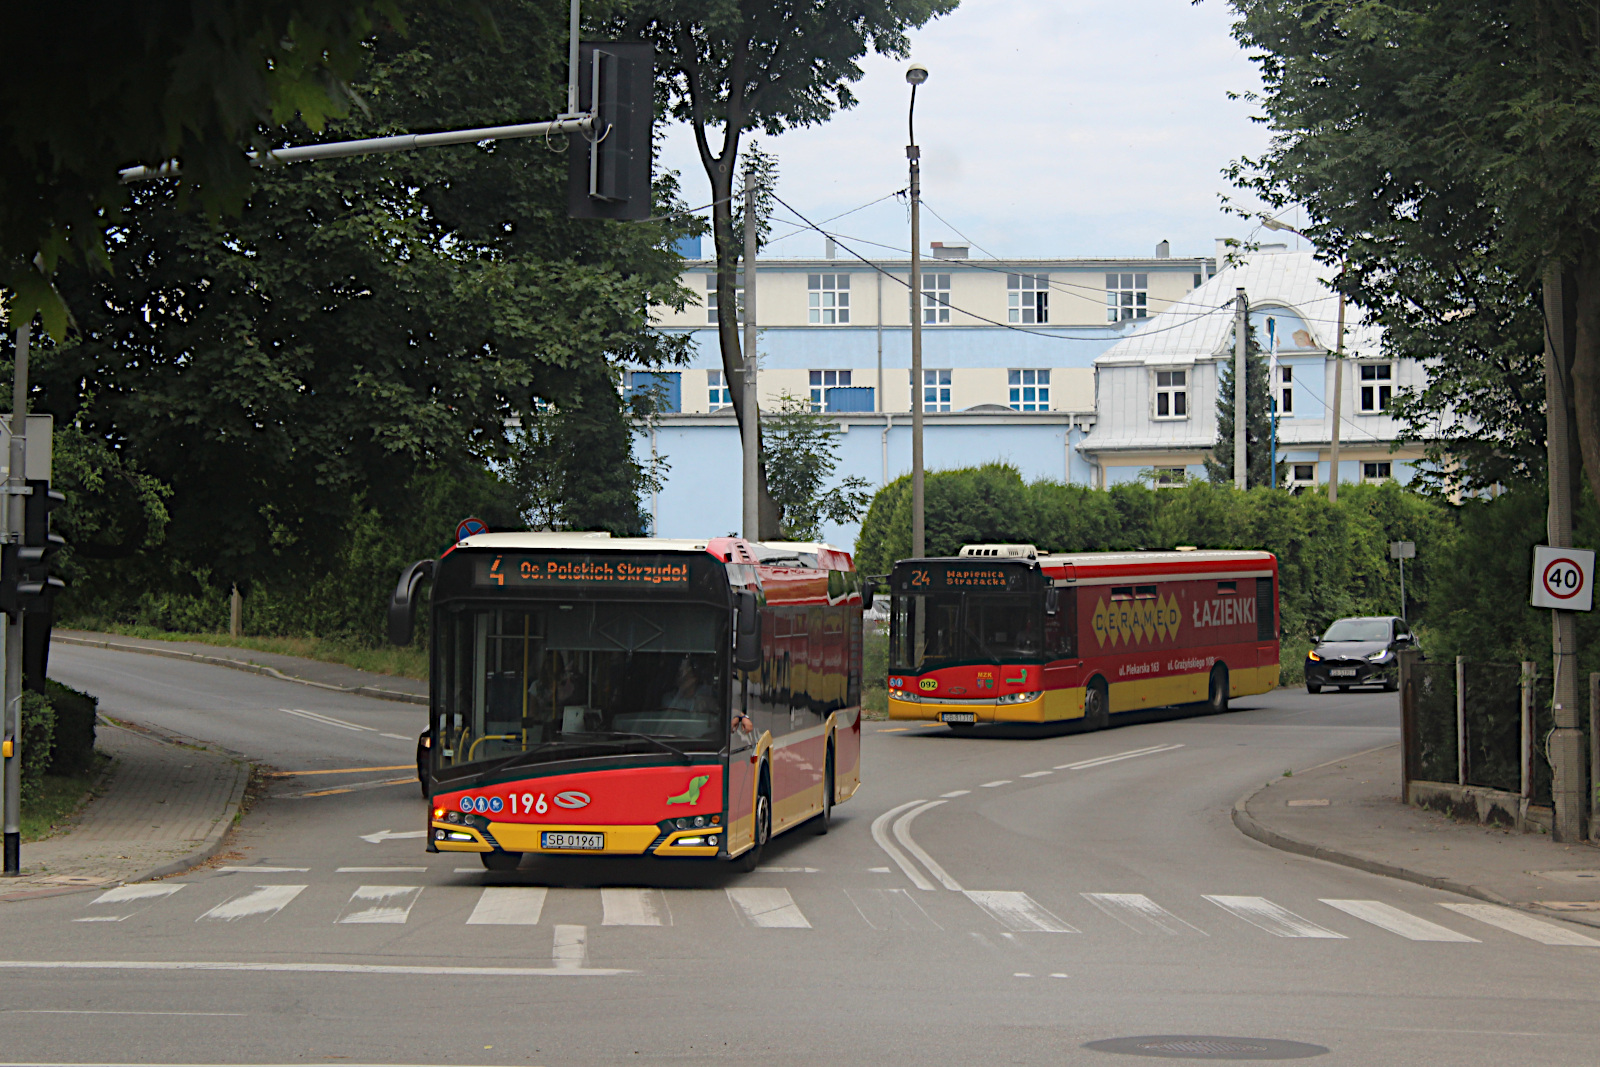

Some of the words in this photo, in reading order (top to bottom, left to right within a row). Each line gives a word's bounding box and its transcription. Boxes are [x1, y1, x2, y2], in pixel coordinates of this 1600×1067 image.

[490, 555, 504, 585] 4
[911, 570, 930, 586] 24
[946, 570, 1004, 578] Wapienica
[1549, 568, 1577, 588] 40
[1096, 608, 1177, 631] CERAMED
[1193, 597, 1256, 628] ŁAZIENKI
[1126, 662, 1150, 676] Piekarska
[1150, 661, 1160, 673] 163
[508, 794, 547, 814] 196
[548, 834, 564, 846] SB
[567, 835, 602, 847] 0196T
